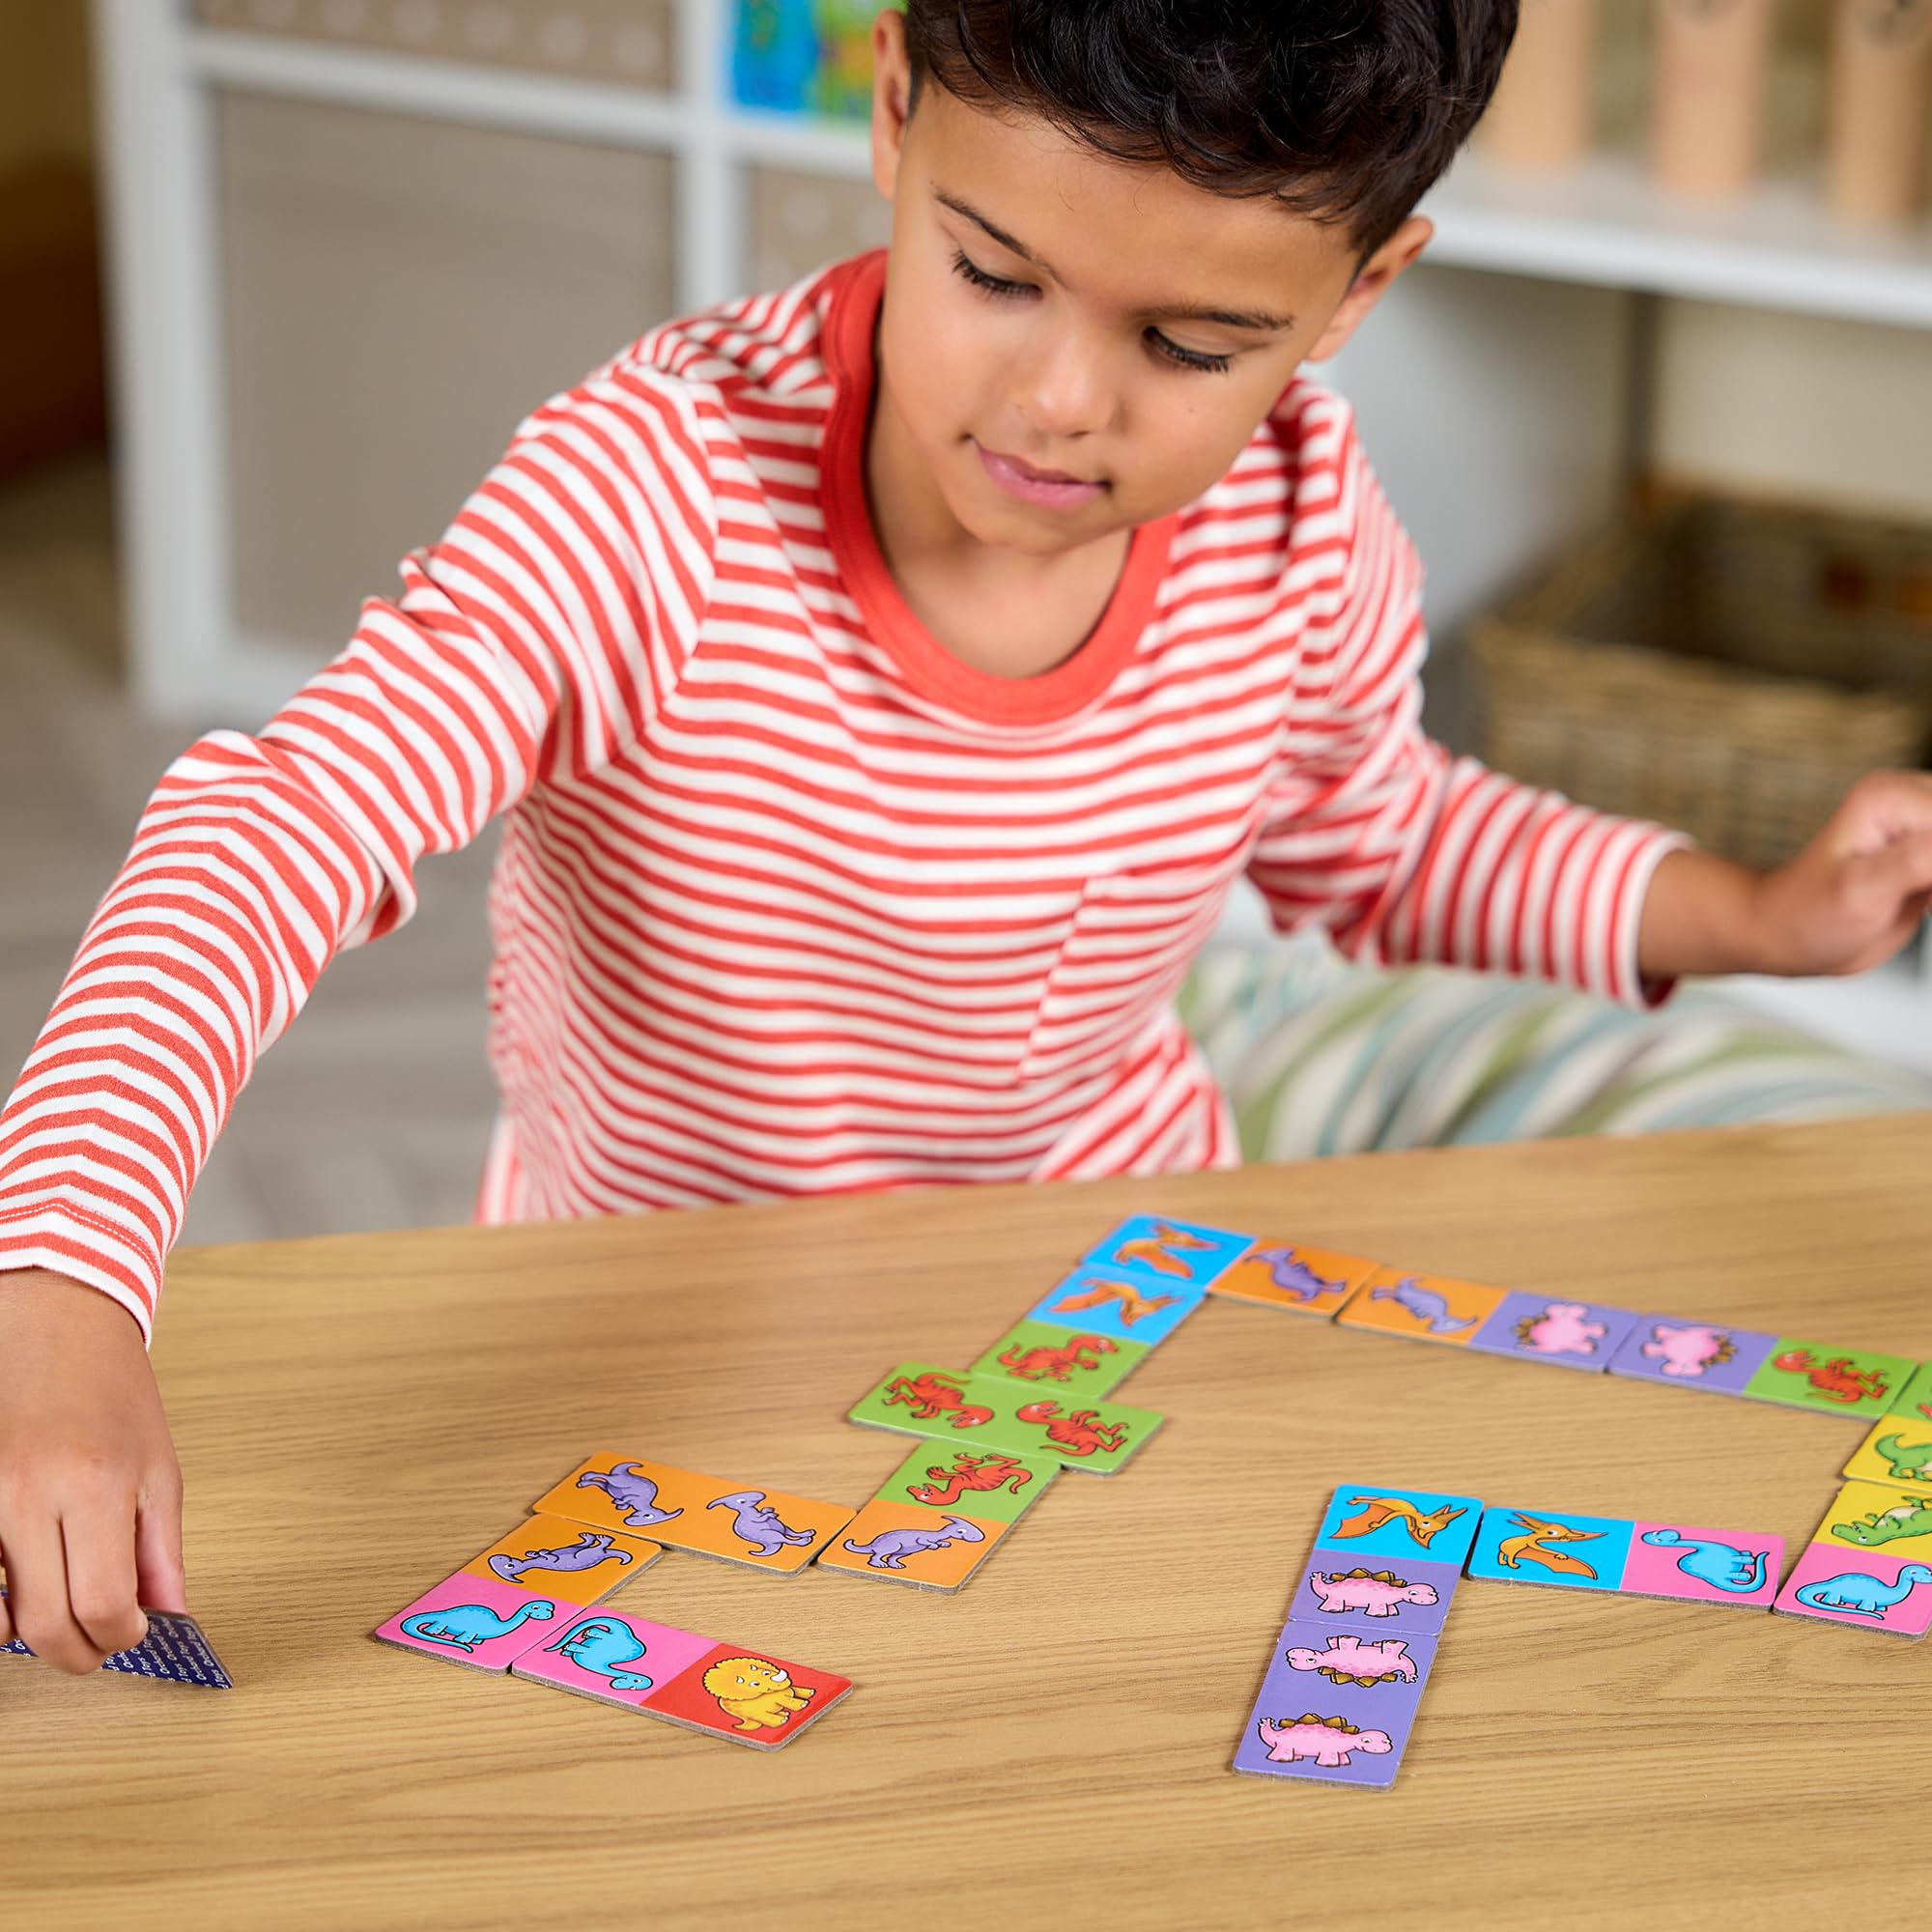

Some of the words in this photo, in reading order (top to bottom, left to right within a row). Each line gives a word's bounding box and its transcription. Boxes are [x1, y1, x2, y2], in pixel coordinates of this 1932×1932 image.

[176, 1640, 189, 1657] Toys
[138, 1657, 152, 1671] Toys
[146, 1649, 170, 1674] Orchard
[183, 1656, 207, 1680] Orchard
[175, 1663, 188, 1677] Toys
[212, 1668, 225, 1684] Toys
